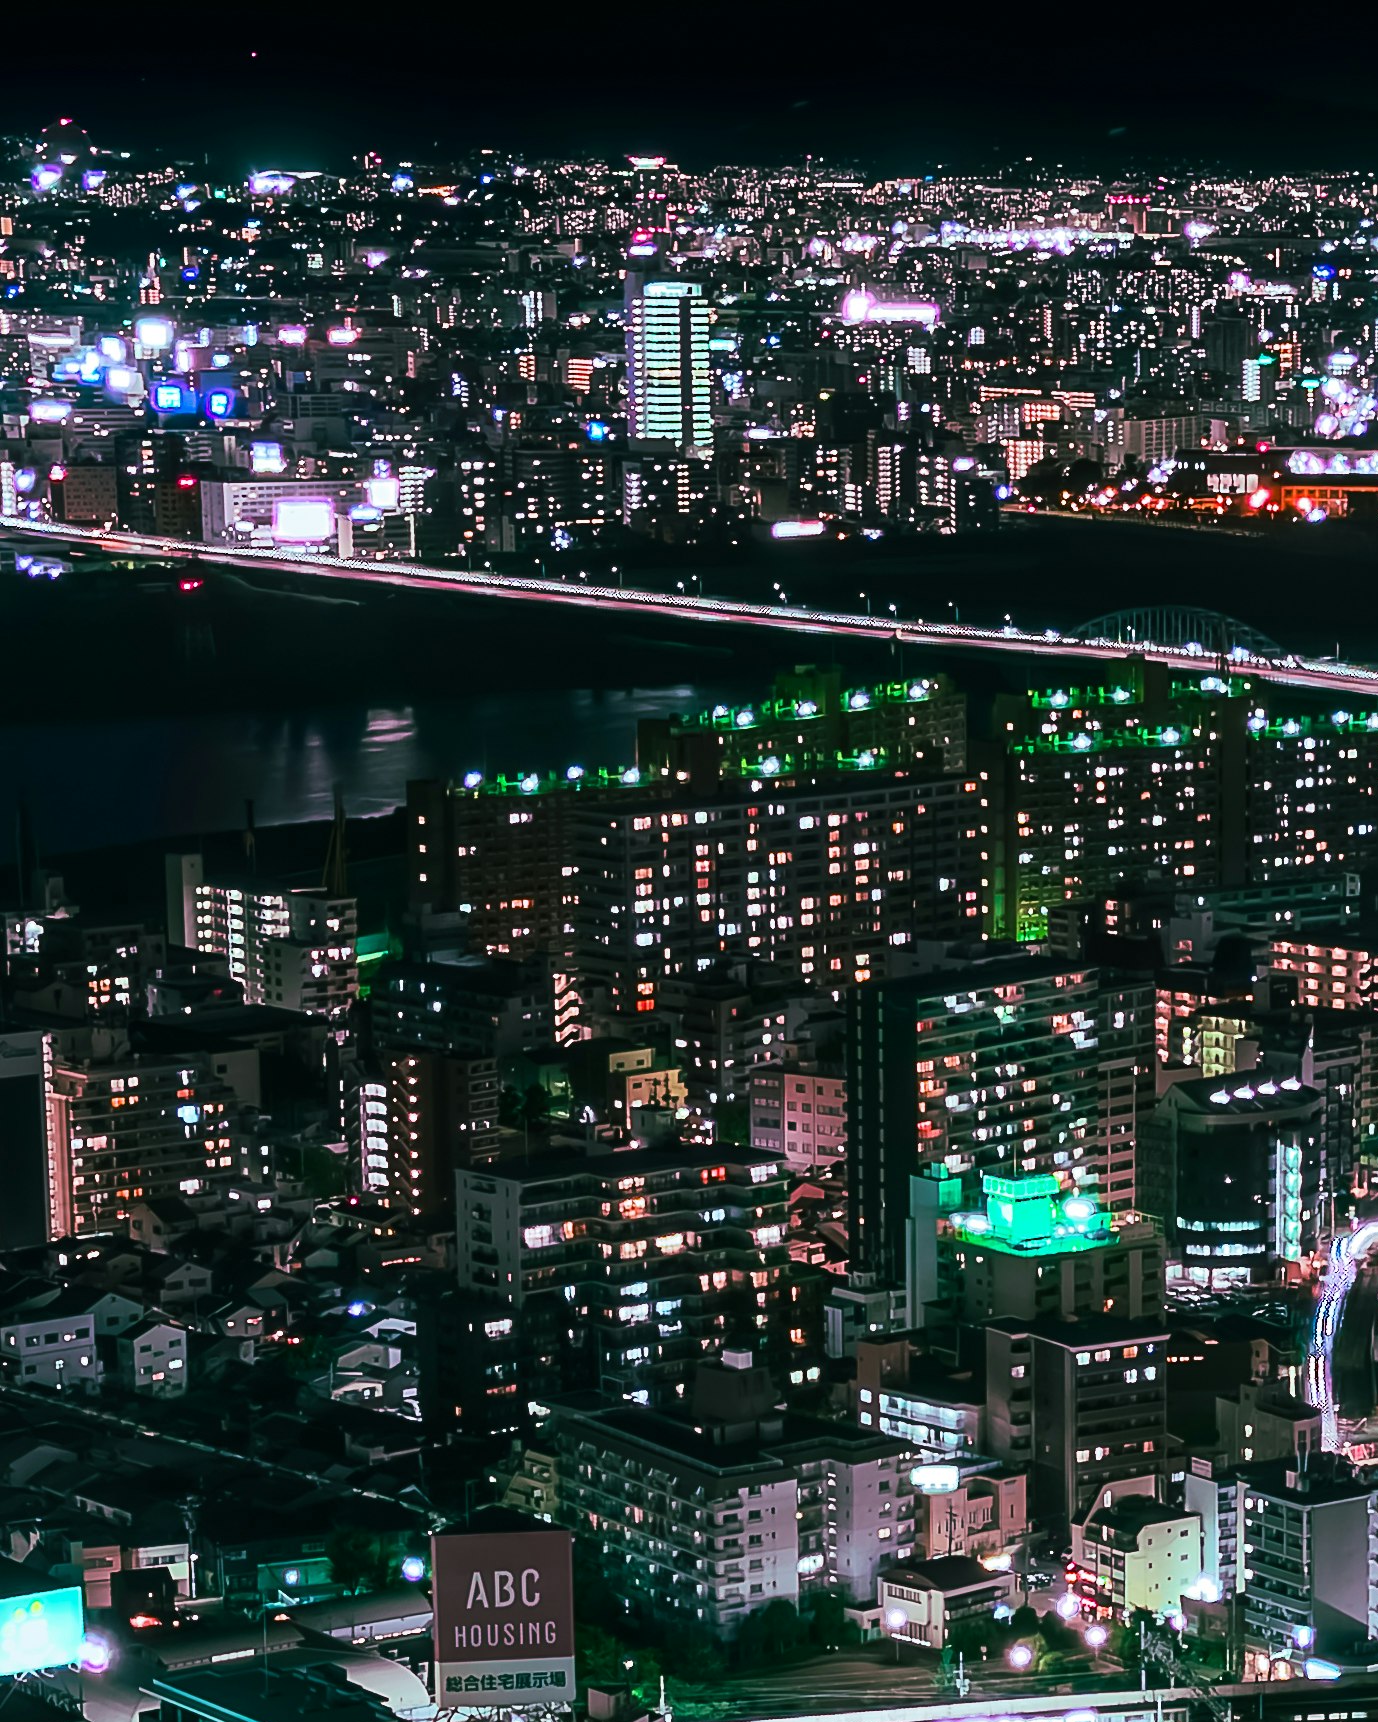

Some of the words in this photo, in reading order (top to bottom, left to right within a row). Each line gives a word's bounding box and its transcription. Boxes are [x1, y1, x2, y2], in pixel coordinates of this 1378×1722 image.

[466, 1568, 541, 1610] ABC
[454, 1620, 557, 1648] HOUSING
[445, 1671, 567, 1692] 総合住宅展示場
